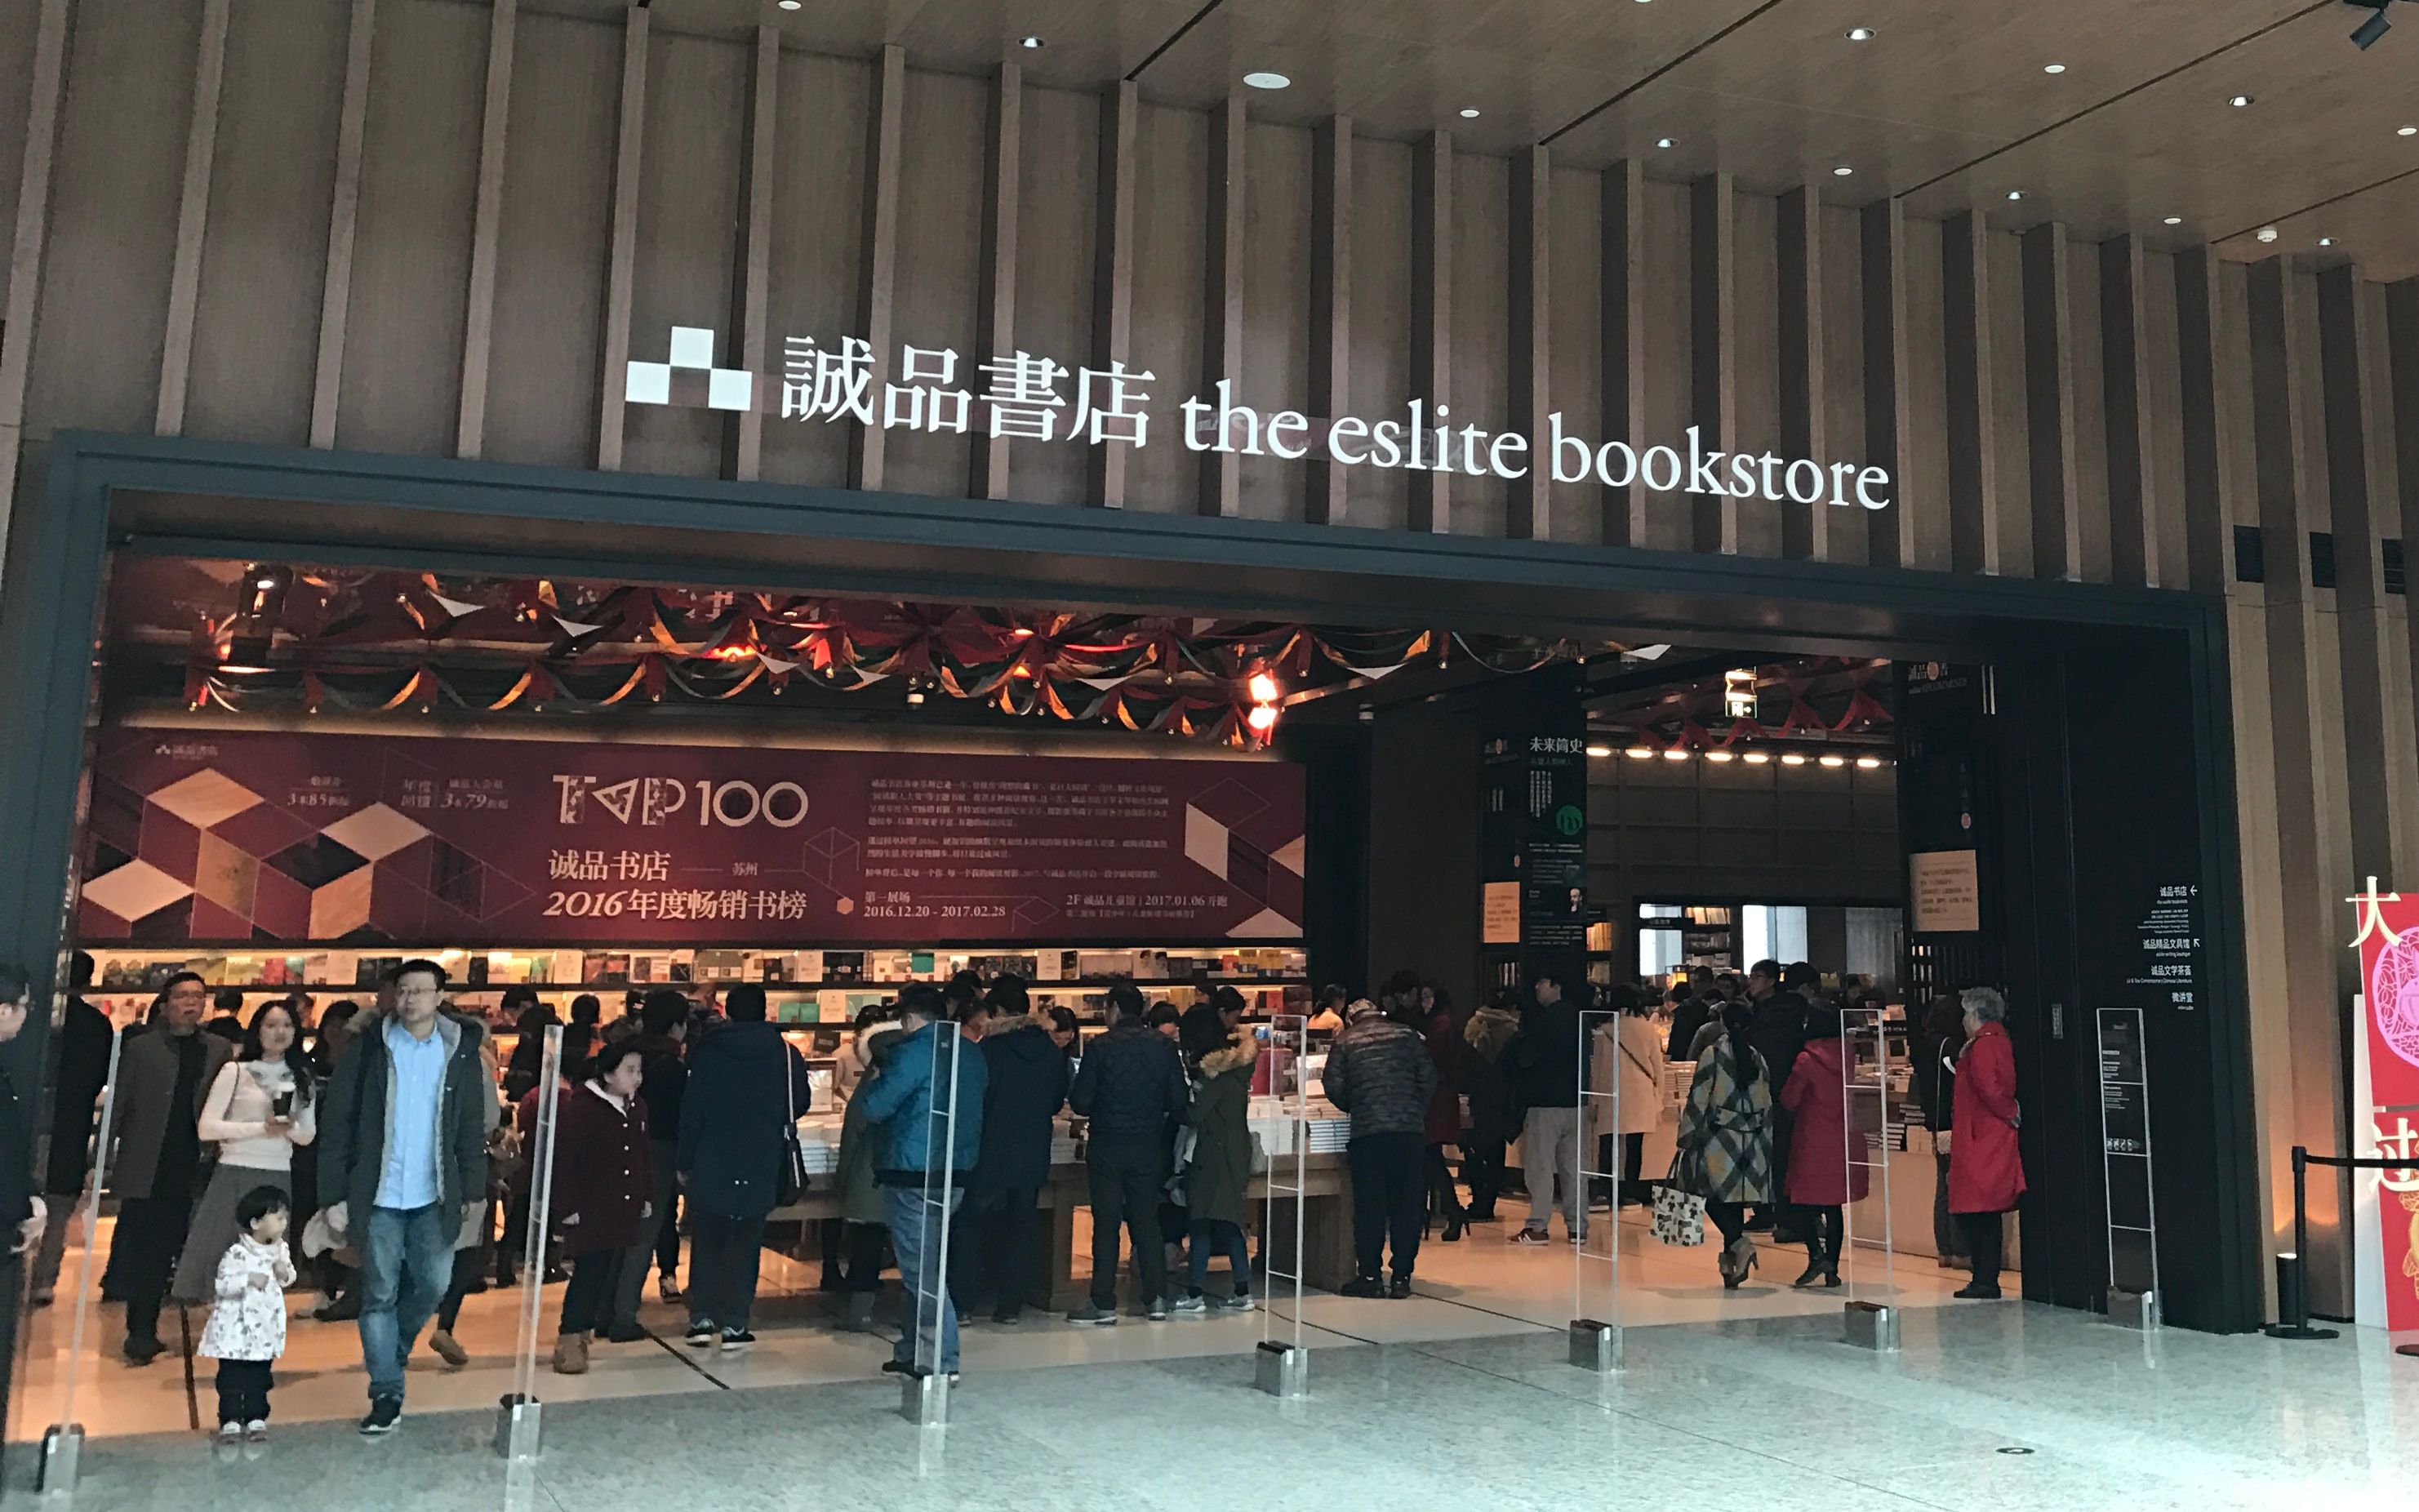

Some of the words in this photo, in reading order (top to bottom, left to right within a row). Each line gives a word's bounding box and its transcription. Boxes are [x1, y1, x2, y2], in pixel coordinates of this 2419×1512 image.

[781, 336, 1155, 448] 誠品書店
[1180, 378, 1309, 459] the
[1328, 398, 1528, 479] eslite
[1548, 411, 1890, 510] bookstore
[1529, 736, 1583, 754] 未来简史
[549, 849, 670, 881] 诚品书店
[732, 862, 758, 876] 苏州
[542, 888, 807, 920] 2016年度畅销书榜
[864, 905, 930, 918] 2016.12.20
[940, 905, 1006, 918] 2017.02.28
[2345, 876, 2403, 948] 大
